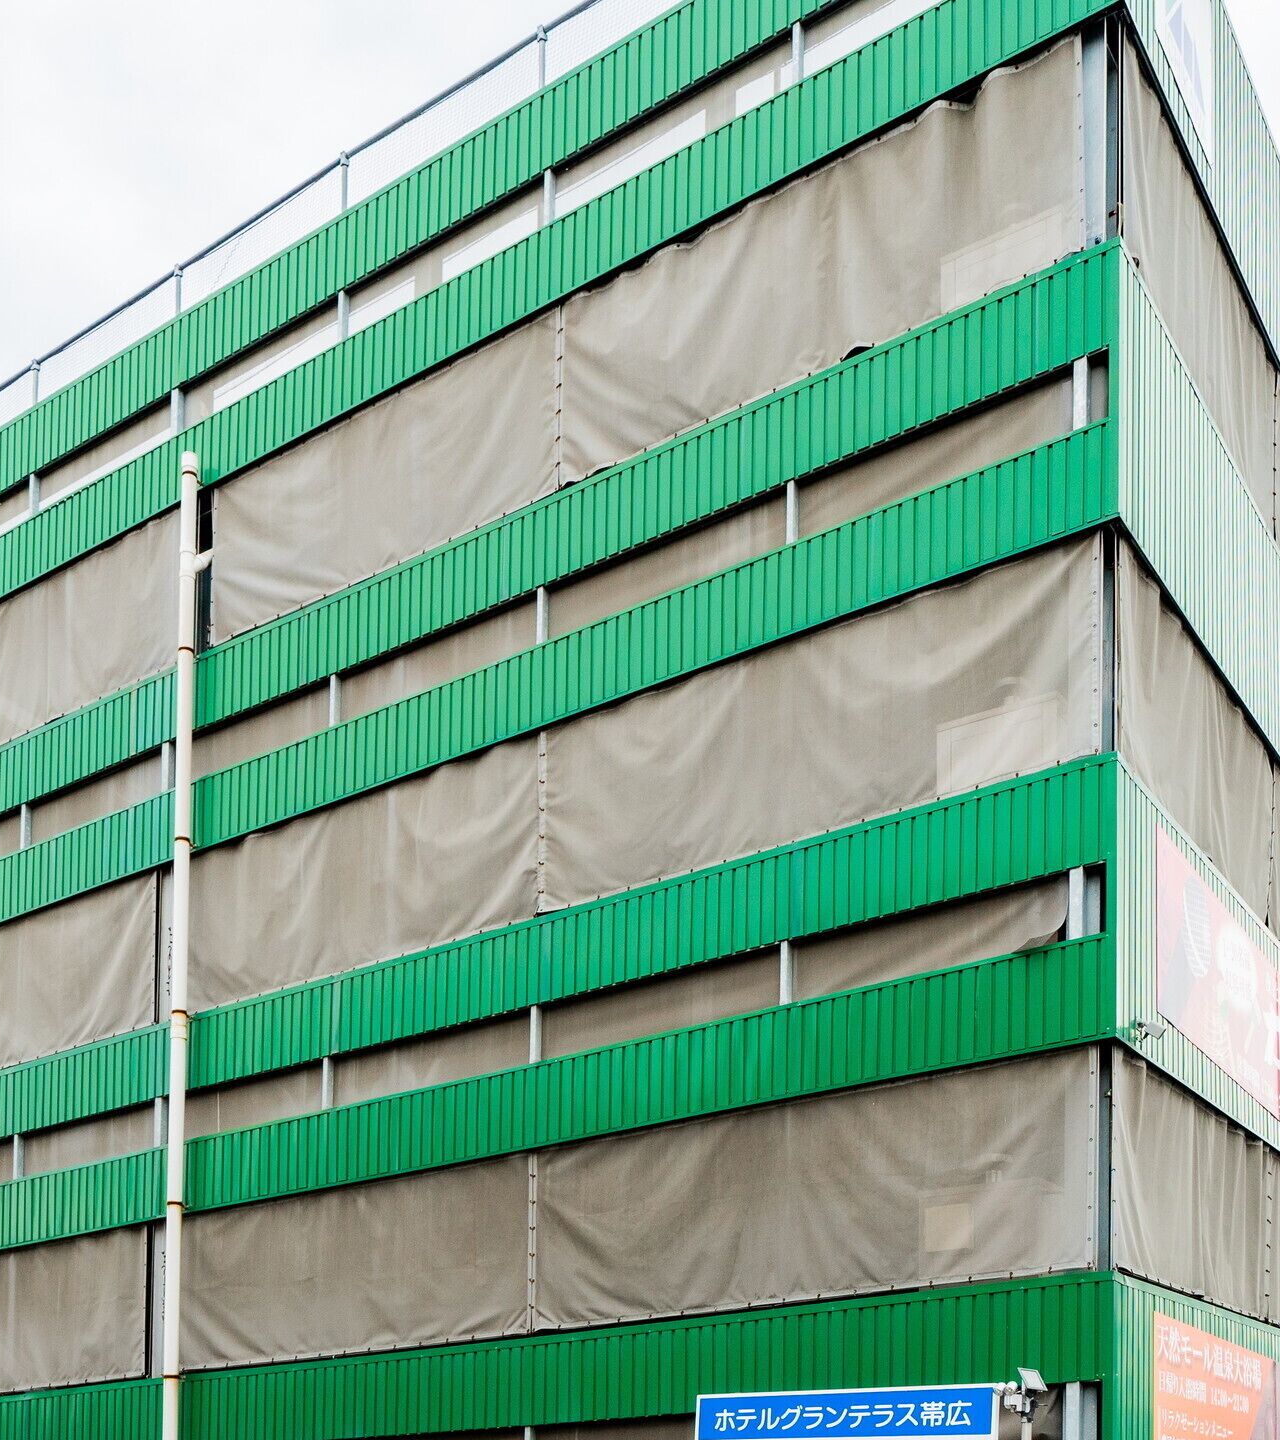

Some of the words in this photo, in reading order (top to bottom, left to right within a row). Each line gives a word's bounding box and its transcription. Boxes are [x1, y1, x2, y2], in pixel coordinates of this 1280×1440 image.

[714, 1400, 973, 1432] ホテルグランテラス帯広
